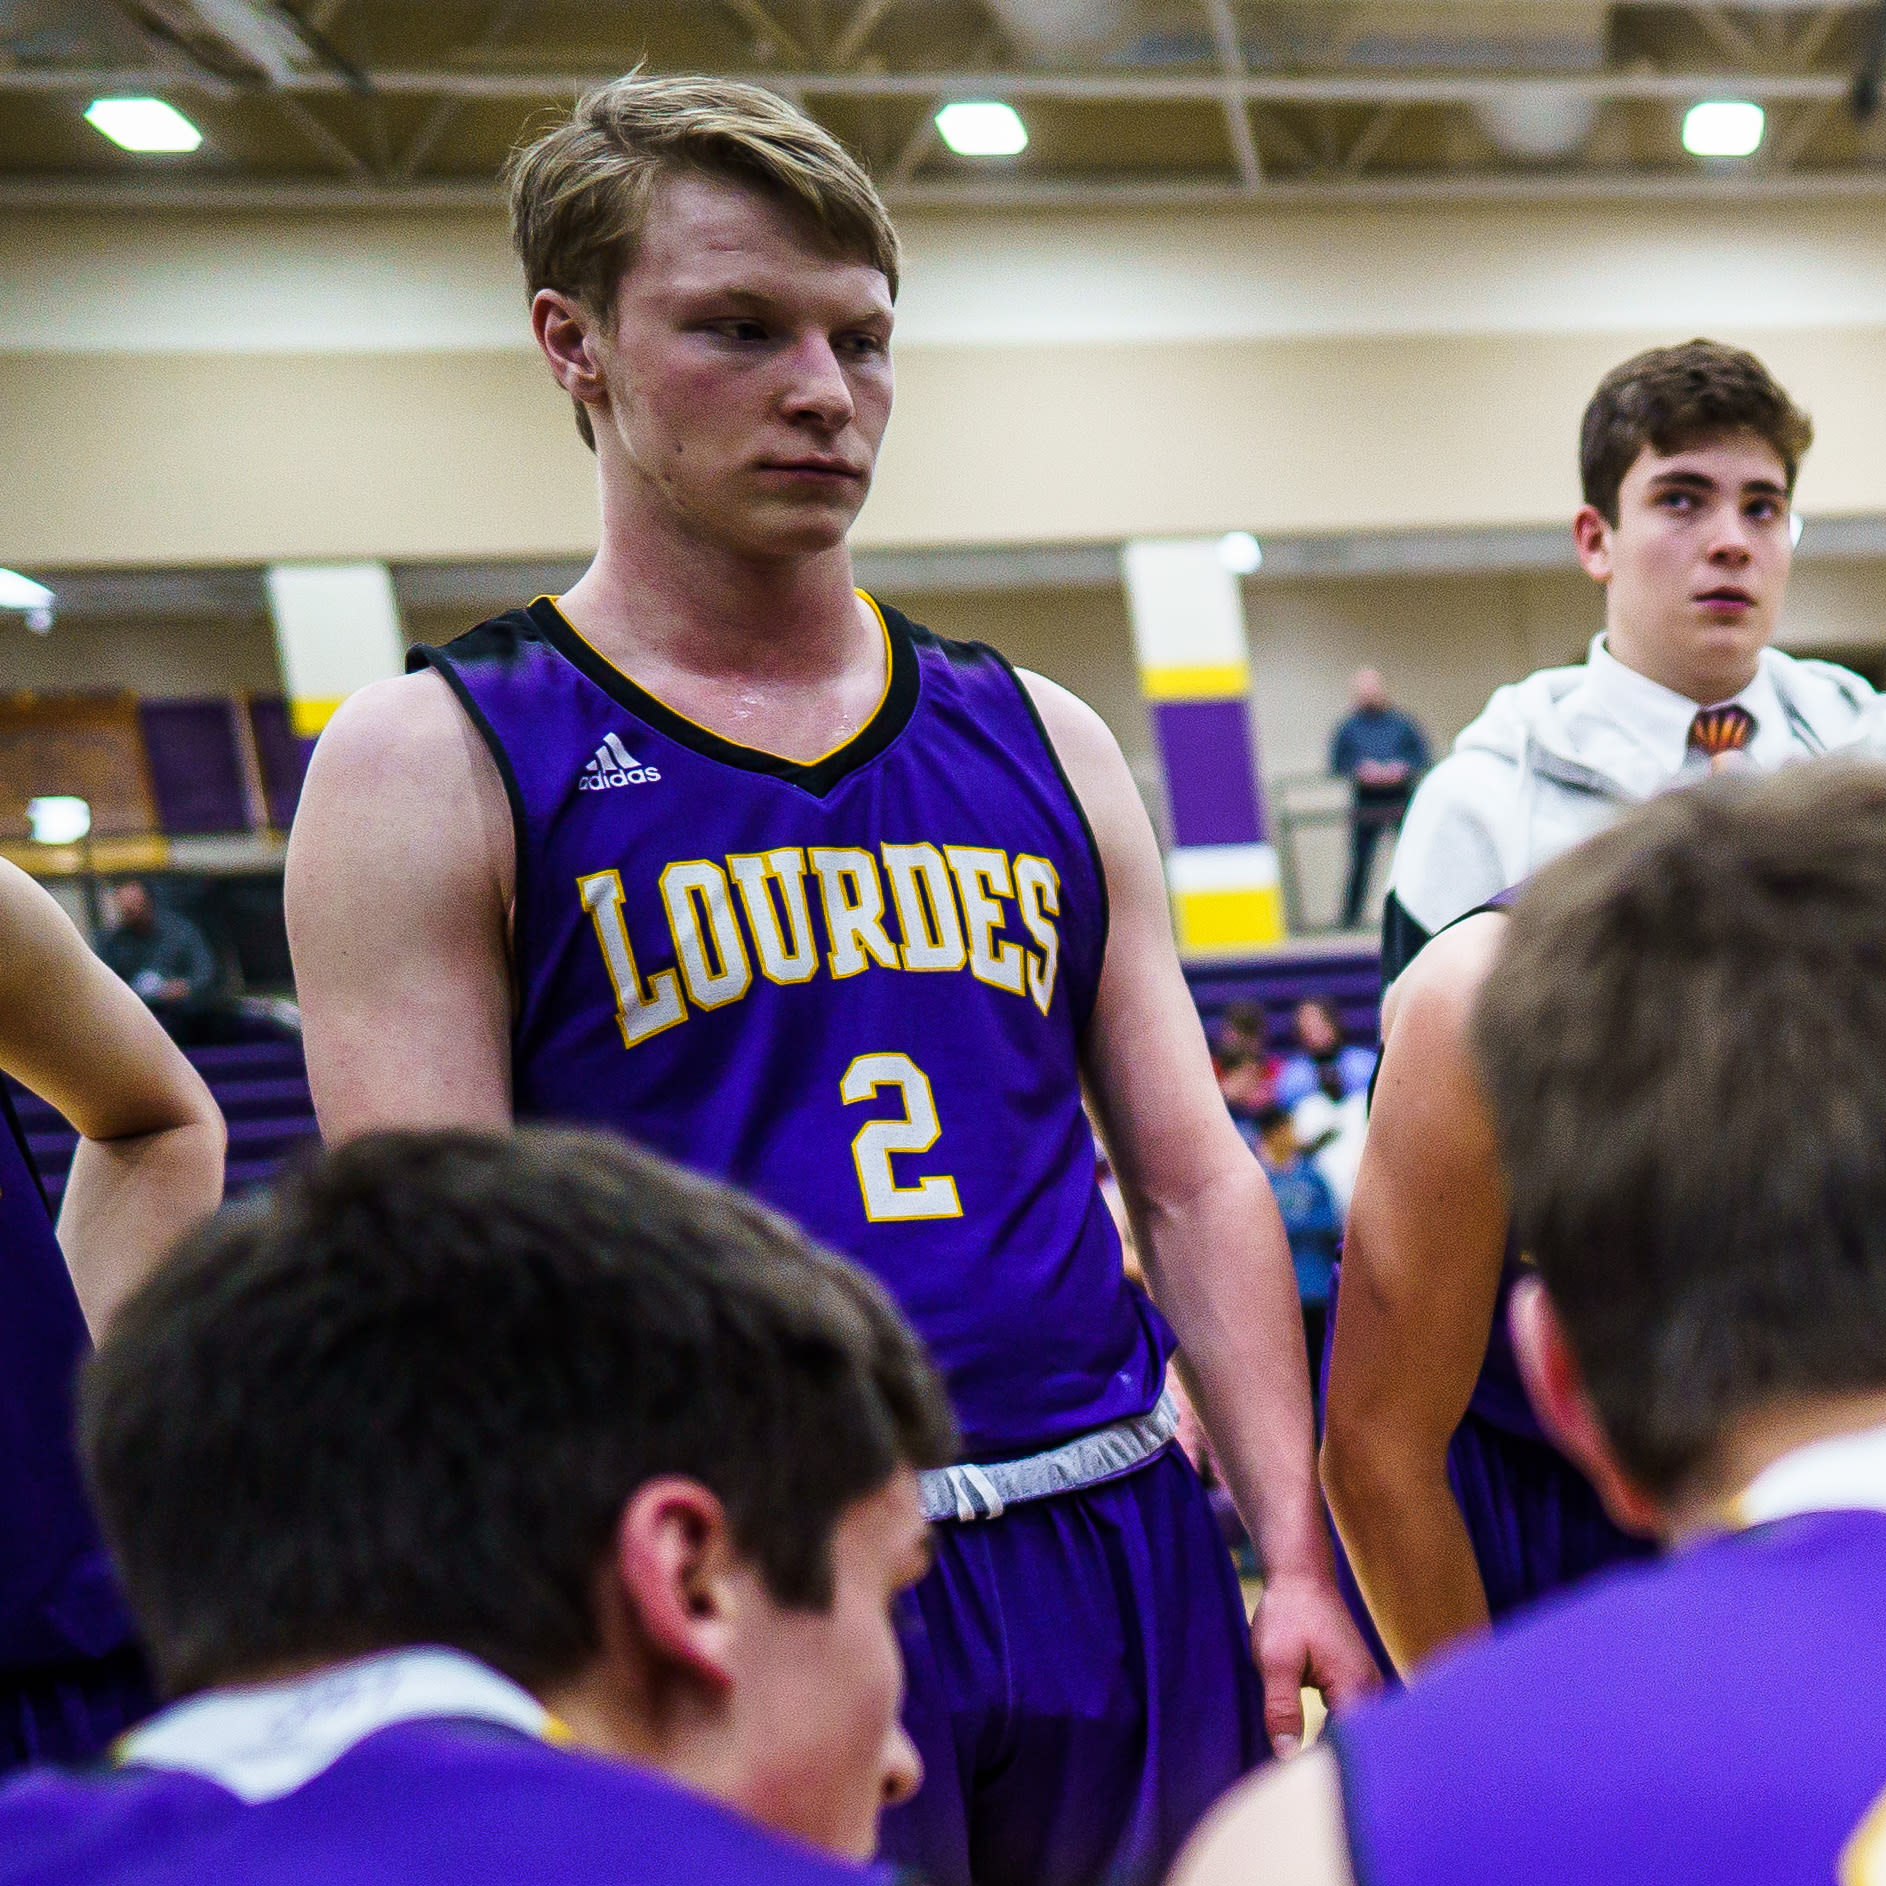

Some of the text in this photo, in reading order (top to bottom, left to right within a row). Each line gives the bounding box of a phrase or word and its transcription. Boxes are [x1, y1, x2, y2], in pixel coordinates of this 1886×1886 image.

[578, 766, 662, 791] adidas
[577, 842, 1062, 1049] LOURDES
[840, 1053, 963, 1223] 2
